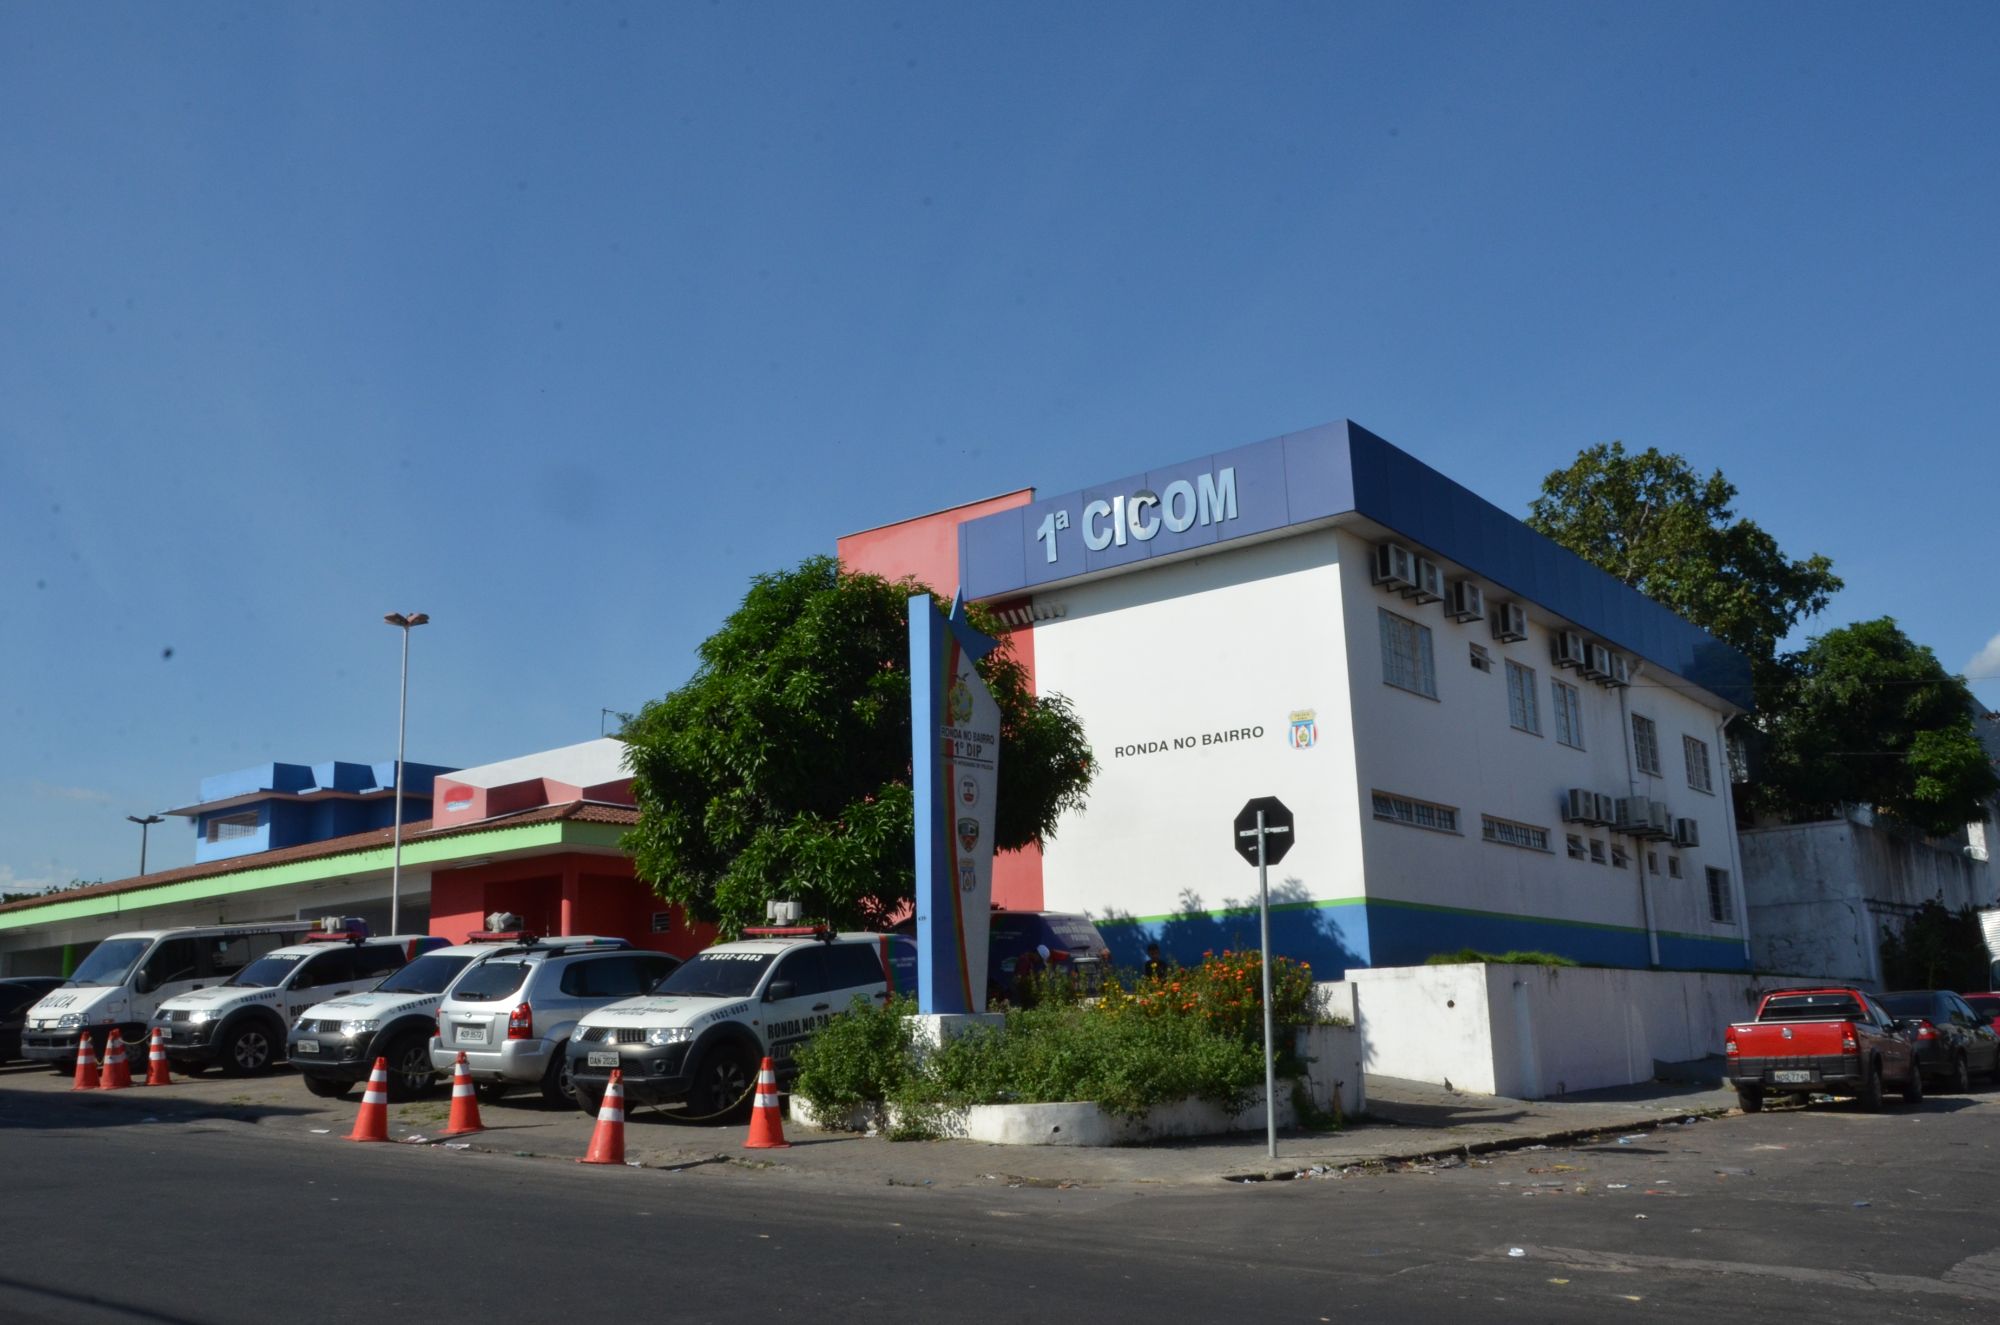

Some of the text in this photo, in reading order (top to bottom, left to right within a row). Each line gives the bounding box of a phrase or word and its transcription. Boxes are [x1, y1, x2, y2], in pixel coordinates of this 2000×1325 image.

[1037, 467, 1239, 563] 1ª CICOM
[963, 730, 972, 741] NO
[973, 731, 995, 745] BAIRRO
[1115, 726, 1265, 758] RONDA NO BAIRRO
[967, 743, 982, 758] DIP
[767, 1019, 801, 1040] RONDA
